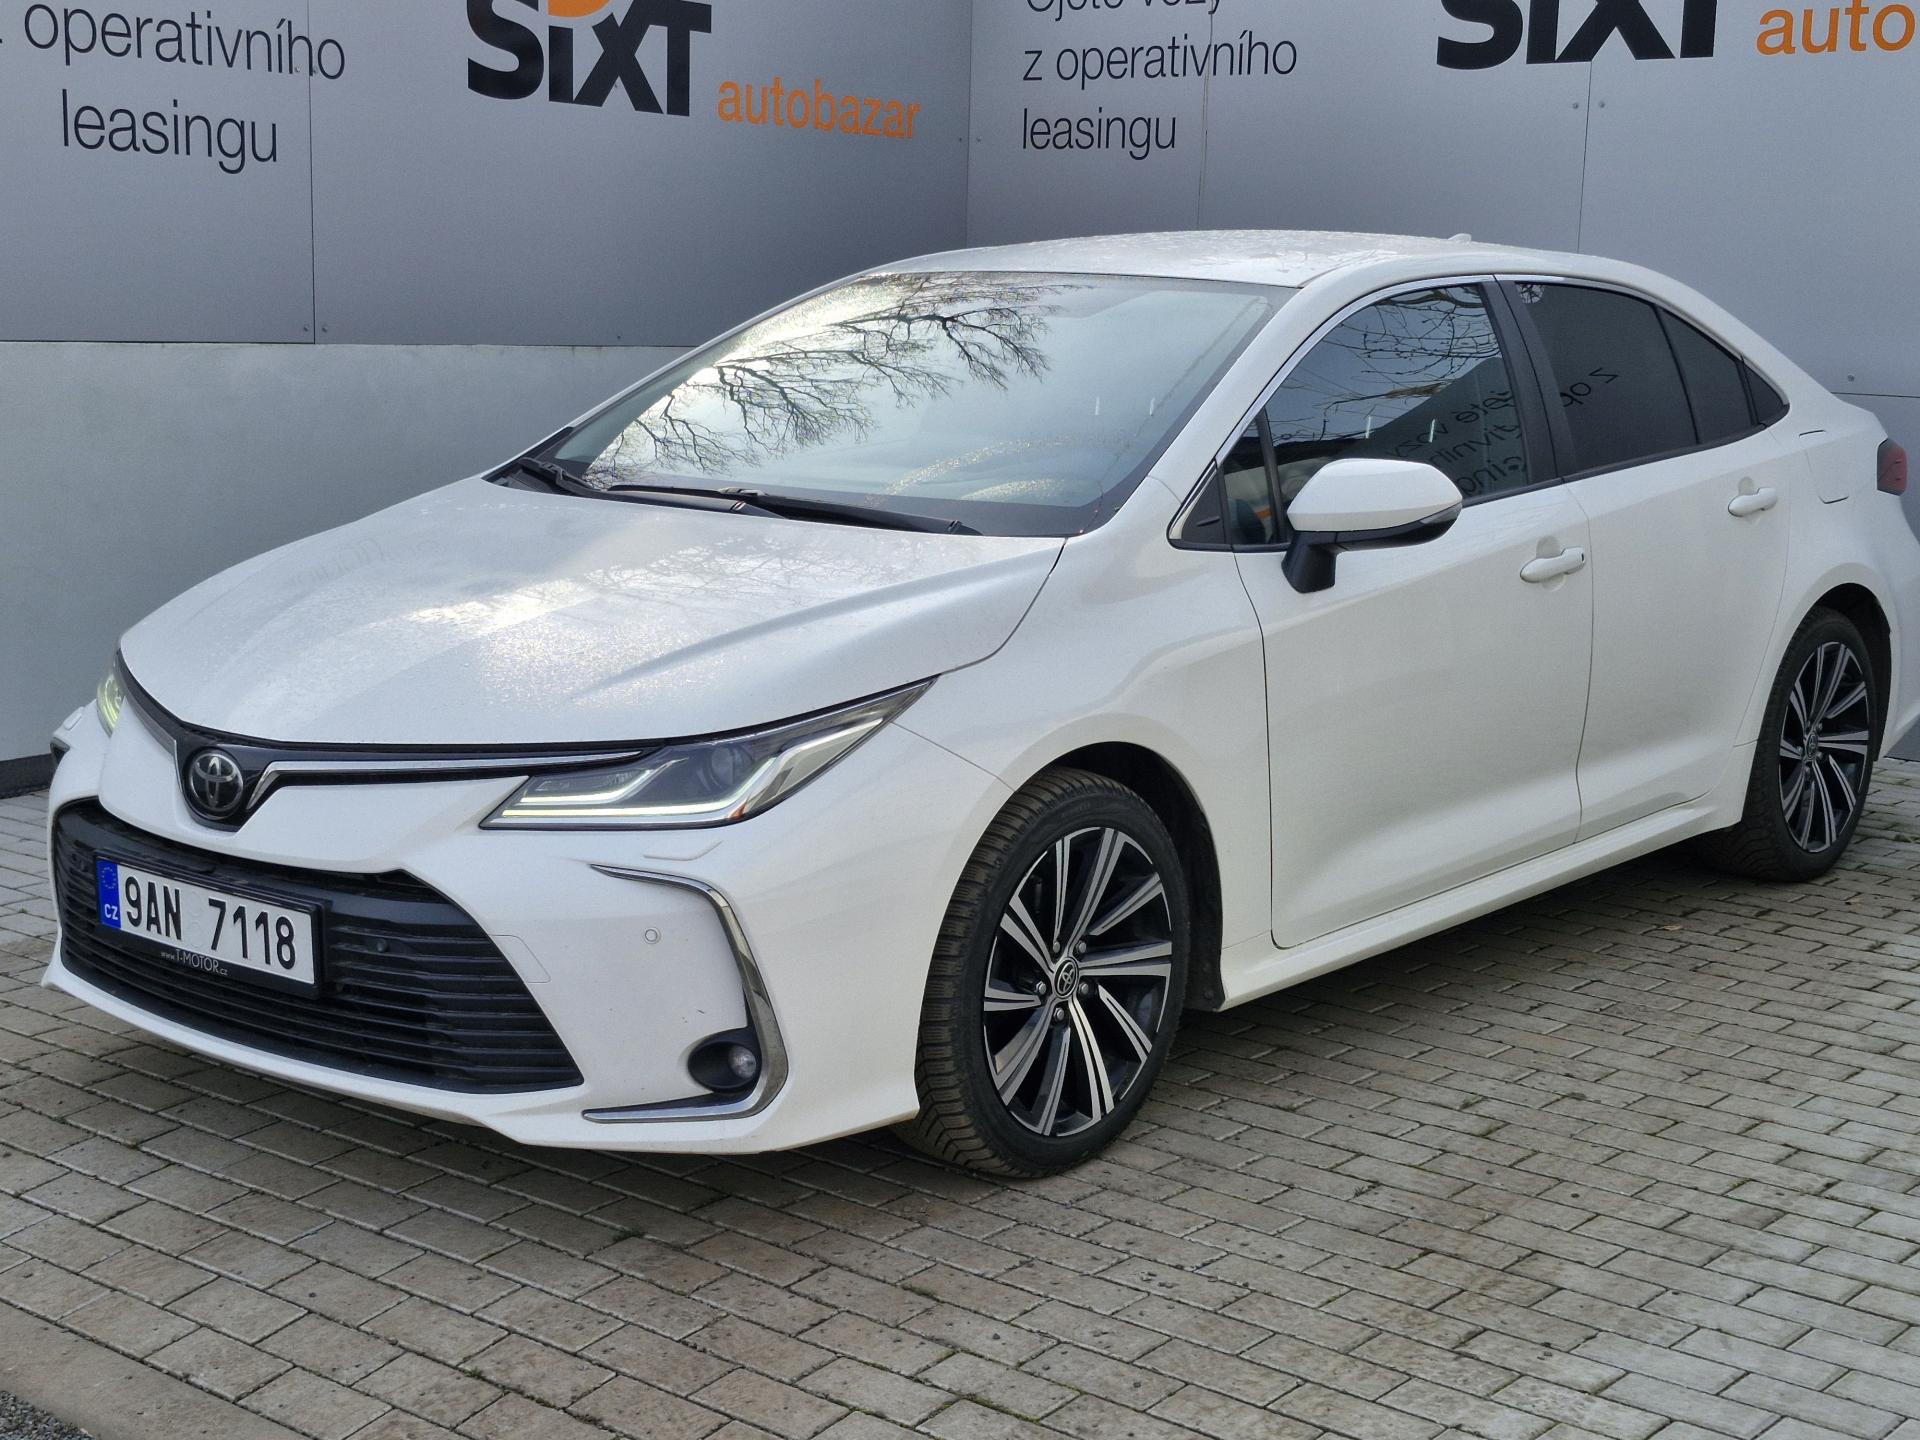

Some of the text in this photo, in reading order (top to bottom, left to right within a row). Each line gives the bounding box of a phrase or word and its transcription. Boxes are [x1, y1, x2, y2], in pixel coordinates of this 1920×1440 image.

[24, 3, 345, 80] operativního
[1022, 30, 1298, 91] z operativního
[62, 88, 278, 175] leasingu
[717, 77, 922, 139] autobazar
[1022, 107, 1177, 161] leasingu
[104, 903, 118, 921] CZ
[125, 876, 295, 970] 9AN 7118
